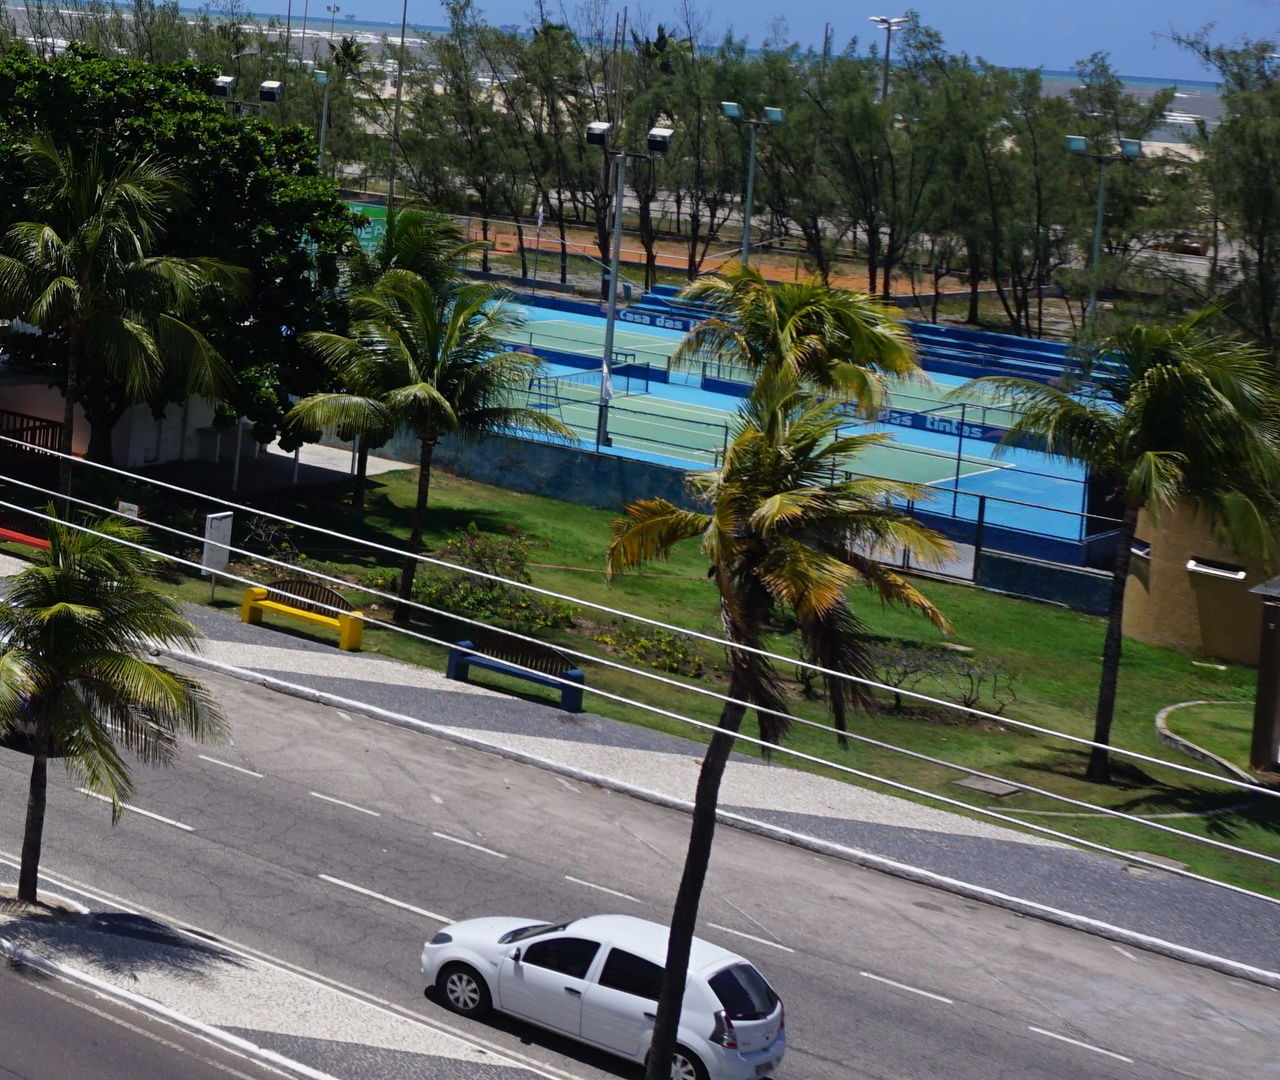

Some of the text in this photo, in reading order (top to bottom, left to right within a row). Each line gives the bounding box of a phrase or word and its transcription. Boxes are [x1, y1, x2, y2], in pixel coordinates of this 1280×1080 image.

[620, 310, 650, 324] Casa
[656, 315, 683, 329] das
[925, 415, 983, 438] tintas
